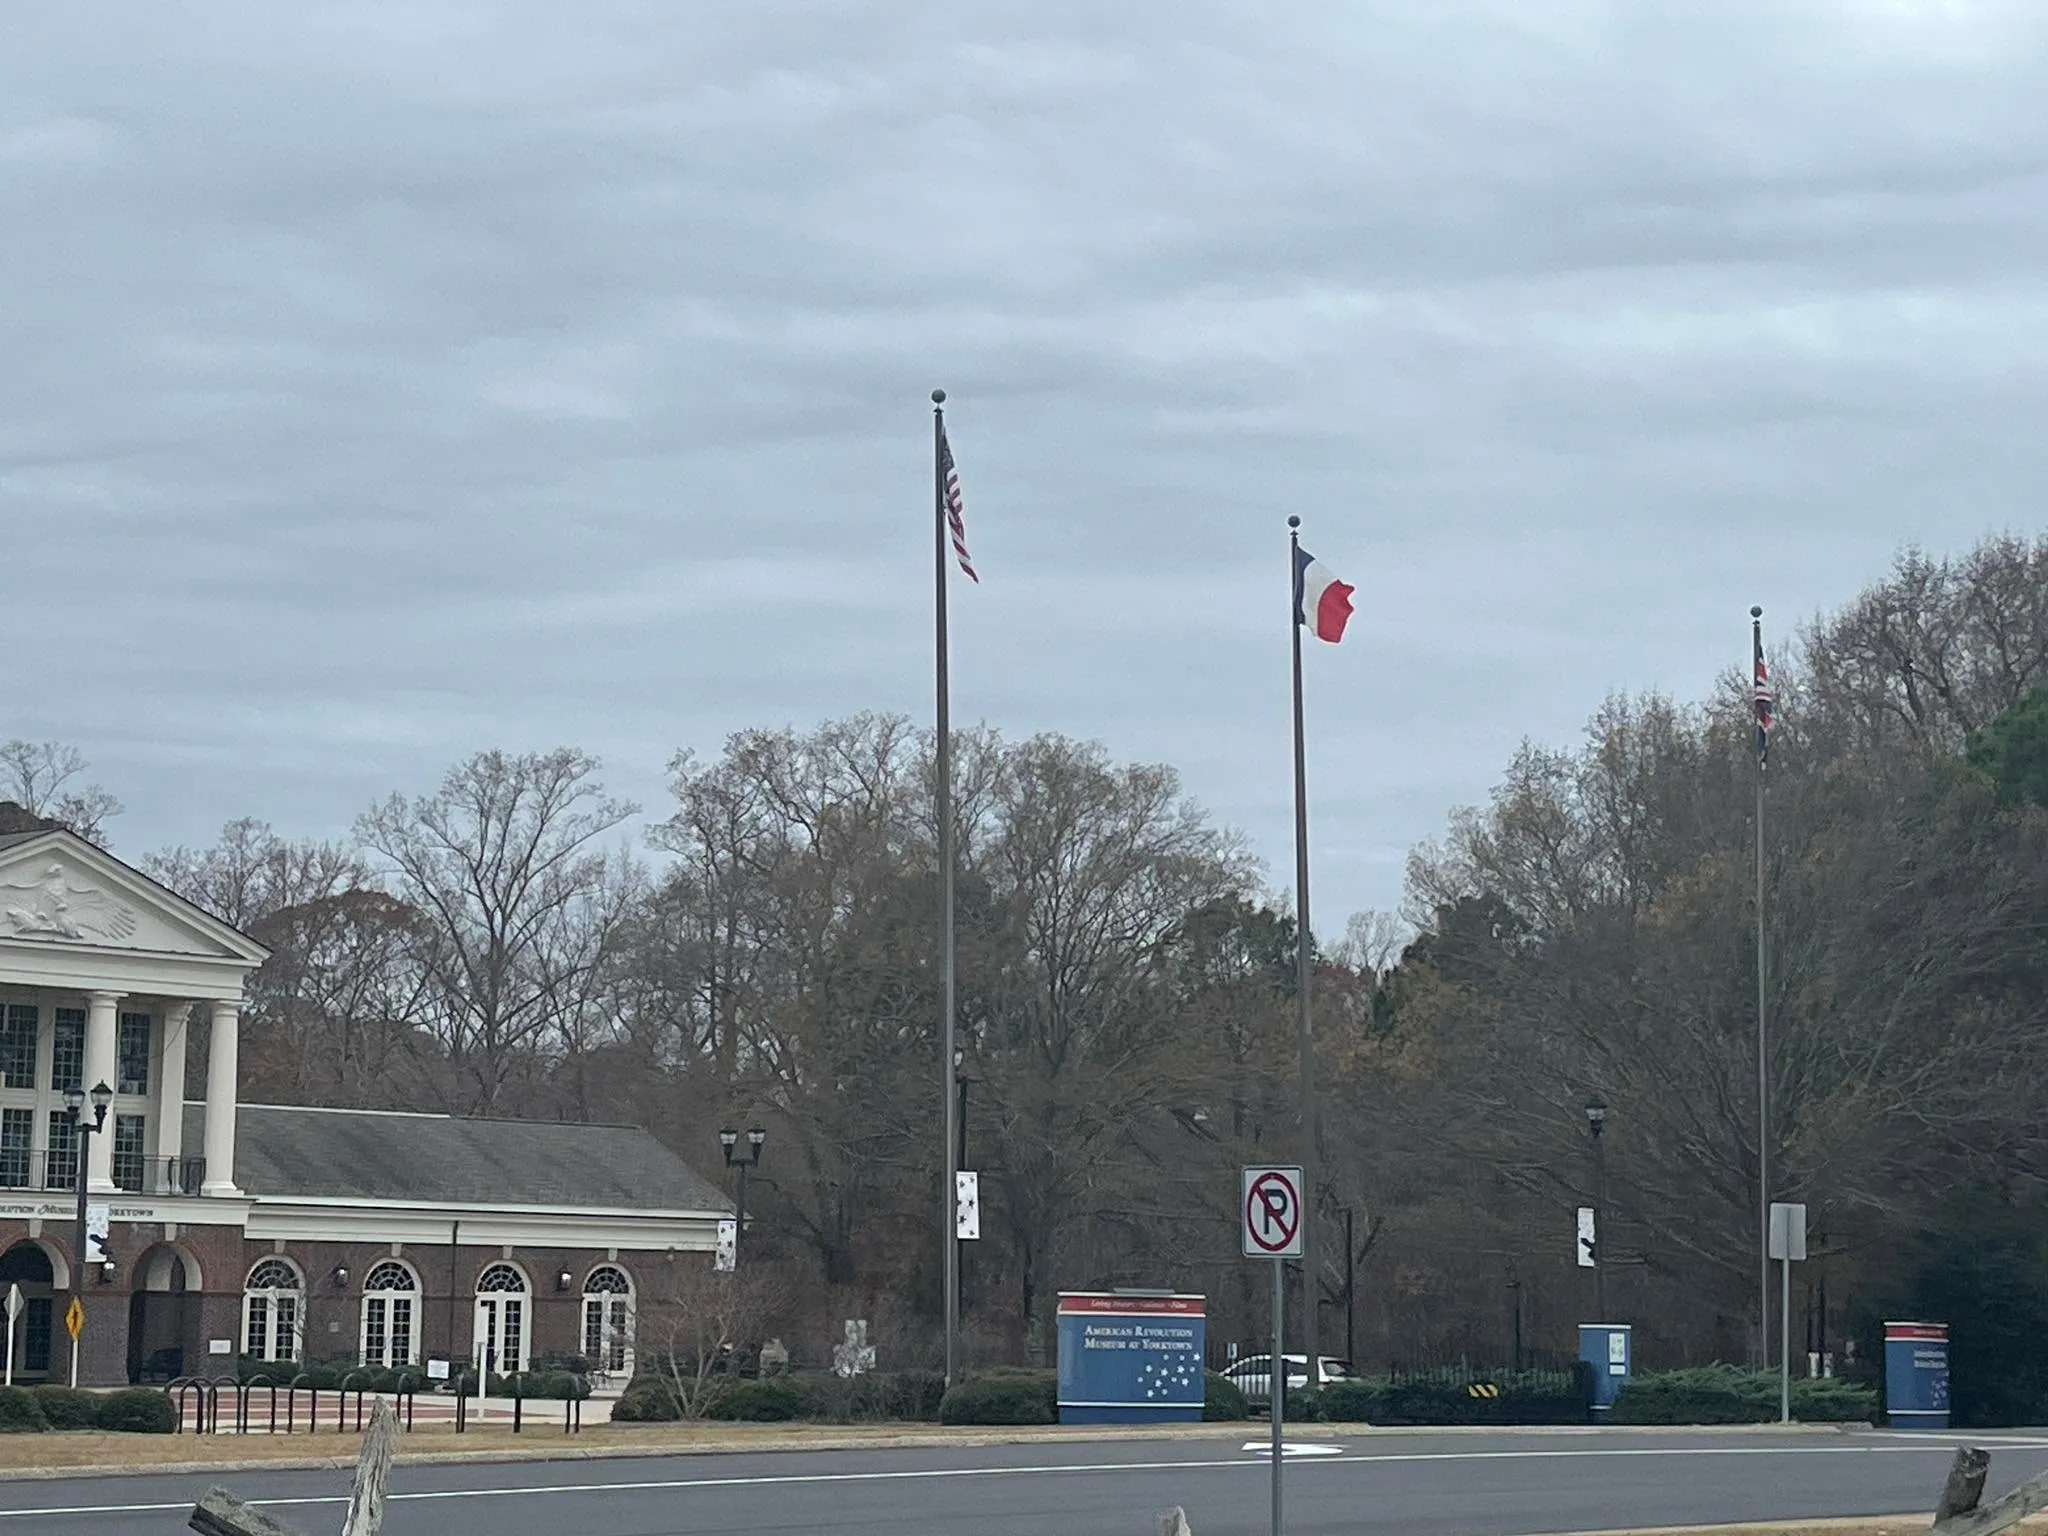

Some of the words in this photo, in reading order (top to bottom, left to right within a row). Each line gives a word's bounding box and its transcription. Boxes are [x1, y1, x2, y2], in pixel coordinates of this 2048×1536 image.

[1085, 1325, 1133, 1336] AMERICAN
[1135, 1326, 1192, 1337] REVOLUTION
[1085, 1338, 1126, 1349] MUSEUM
[1142, 1339, 1193, 1350] YORKTOWN
